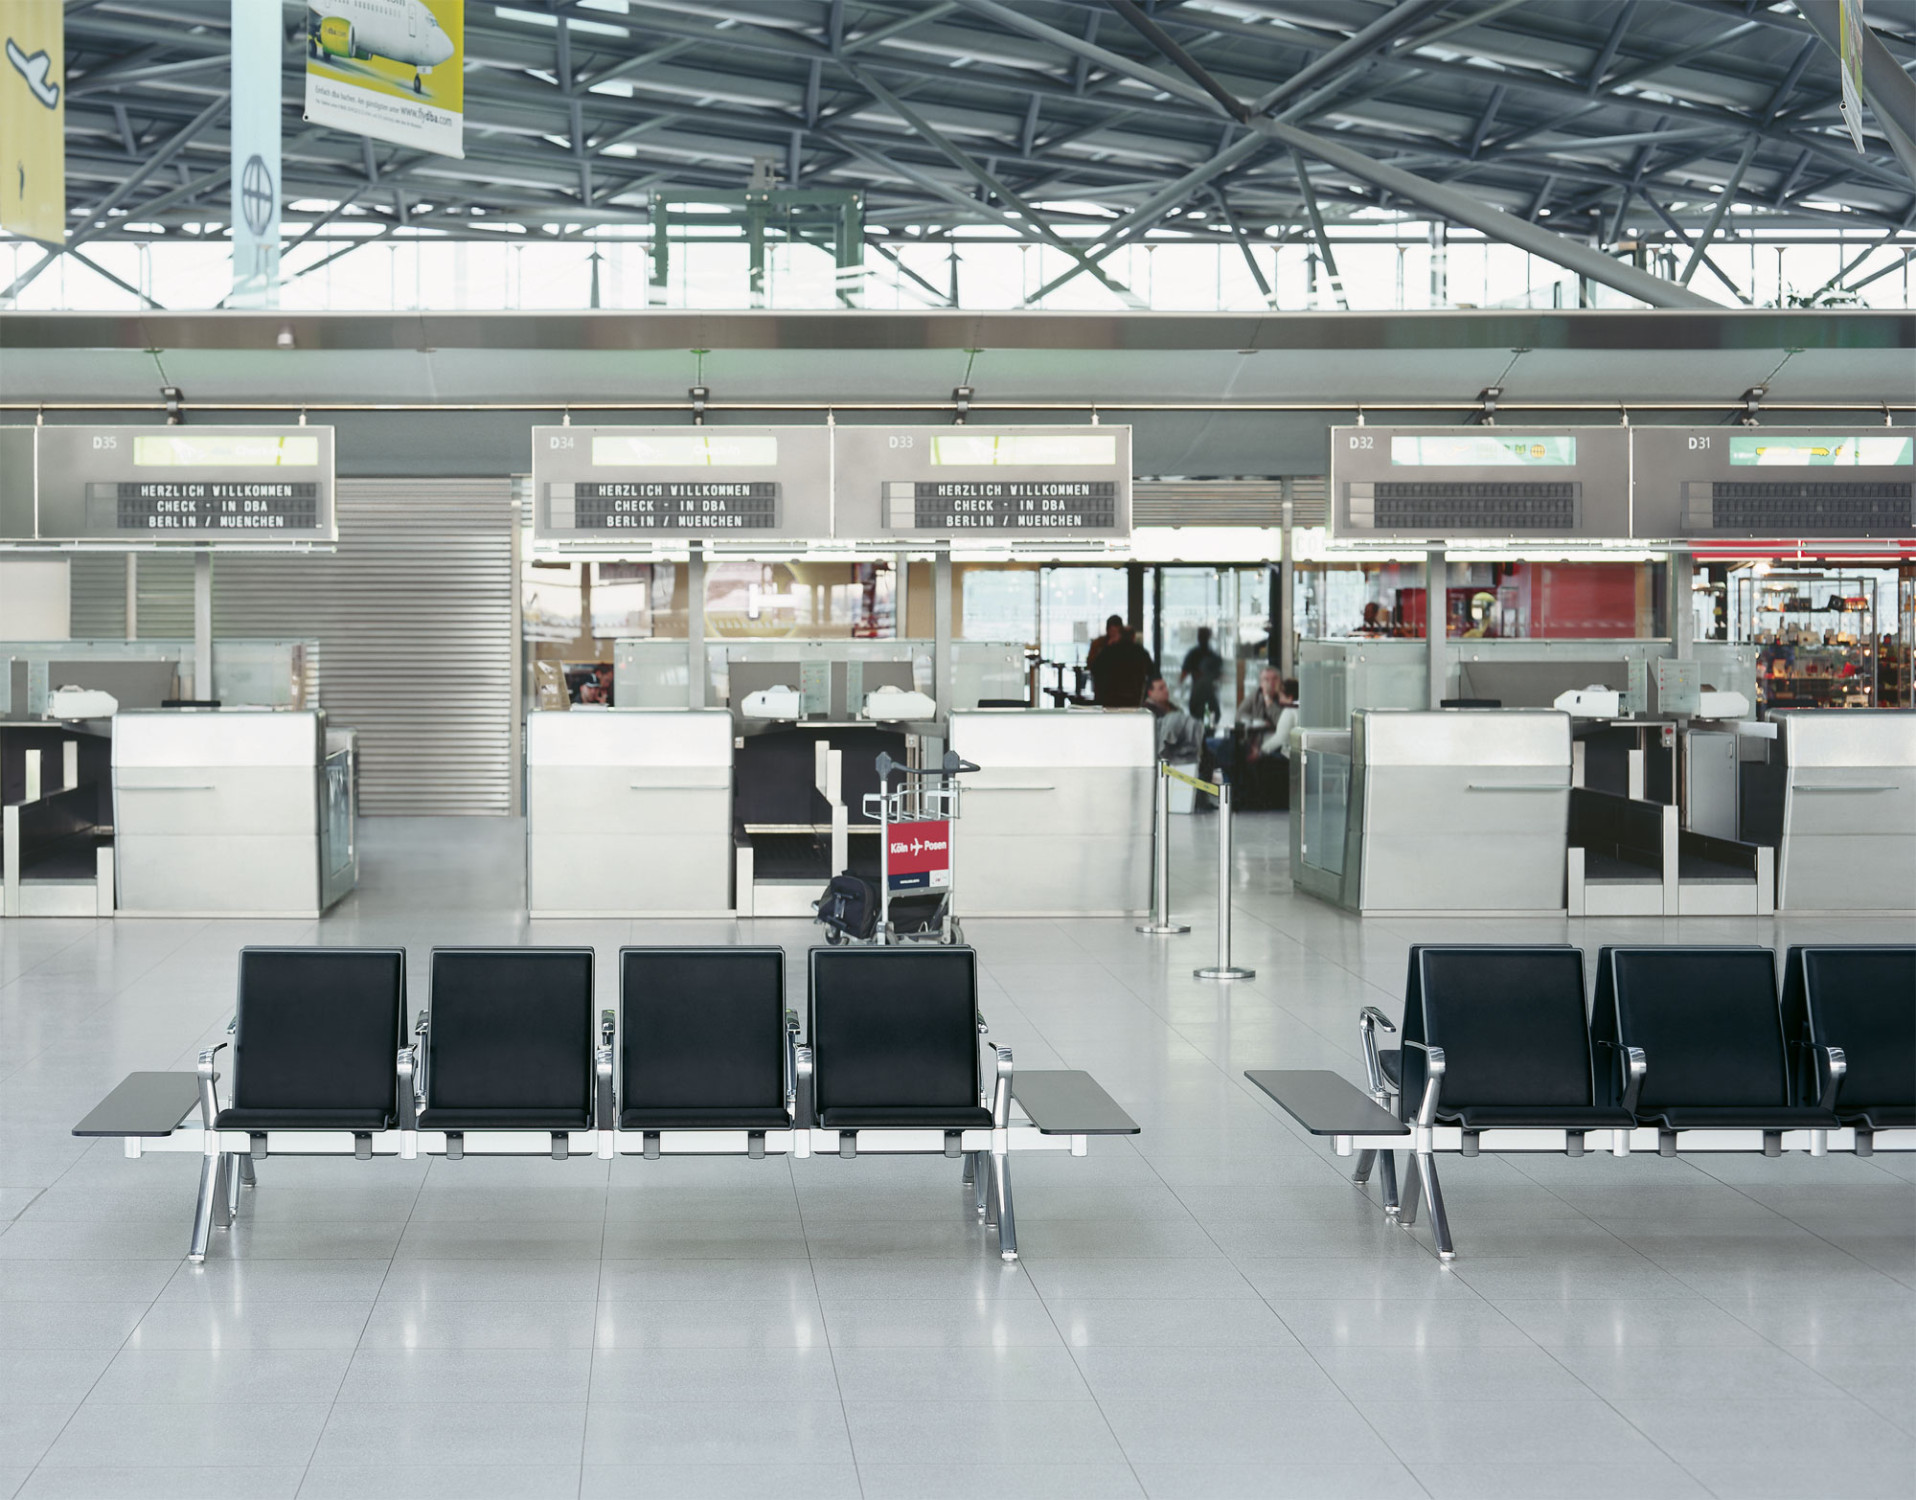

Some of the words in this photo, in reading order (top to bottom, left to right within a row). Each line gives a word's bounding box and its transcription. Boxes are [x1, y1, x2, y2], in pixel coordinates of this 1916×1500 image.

[401, 106, 453, 128] www.flydba.com
[92, 435, 117, 450] D35
[549, 436, 575, 450] D34
[888, 435, 914, 449] D33
[1349, 435, 1374, 450] D32
[1688, 435, 1711, 450] D31
[142, 485, 205, 497] HERZLICH
[213, 485, 292, 497] WILLKOMMEN
[599, 484, 662, 497] HERZLICH
[671, 484, 750, 497] WILLKOMMEN
[938, 484, 1002, 496] HERZLICH
[1010, 484, 1090, 496] WILLKOMMEN
[157, 500, 196, 513] CHECK
[222, 500, 236, 512] IN
[244, 500, 268, 512] DBA
[614, 500, 654, 512] CHECK
[680, 500, 694, 512] IN
[702, 500, 726, 512] DBA
[954, 499, 994, 512] CHECK
[1020, 499, 1034, 511] IN
[1042, 499, 1066, 511] DBA
[148, 515, 197, 528] BERLIN
[220, 515, 284, 528] MUENCHEN
[606, 515, 655, 527] BERLIN
[678, 515, 742, 527] MUENCHEN
[946, 514, 994, 527] BERLIN
[1017, 514, 1082, 527] MUENCHEN
[890, 842, 908, 854] Köln
[924, 840, 947, 851] Posen
